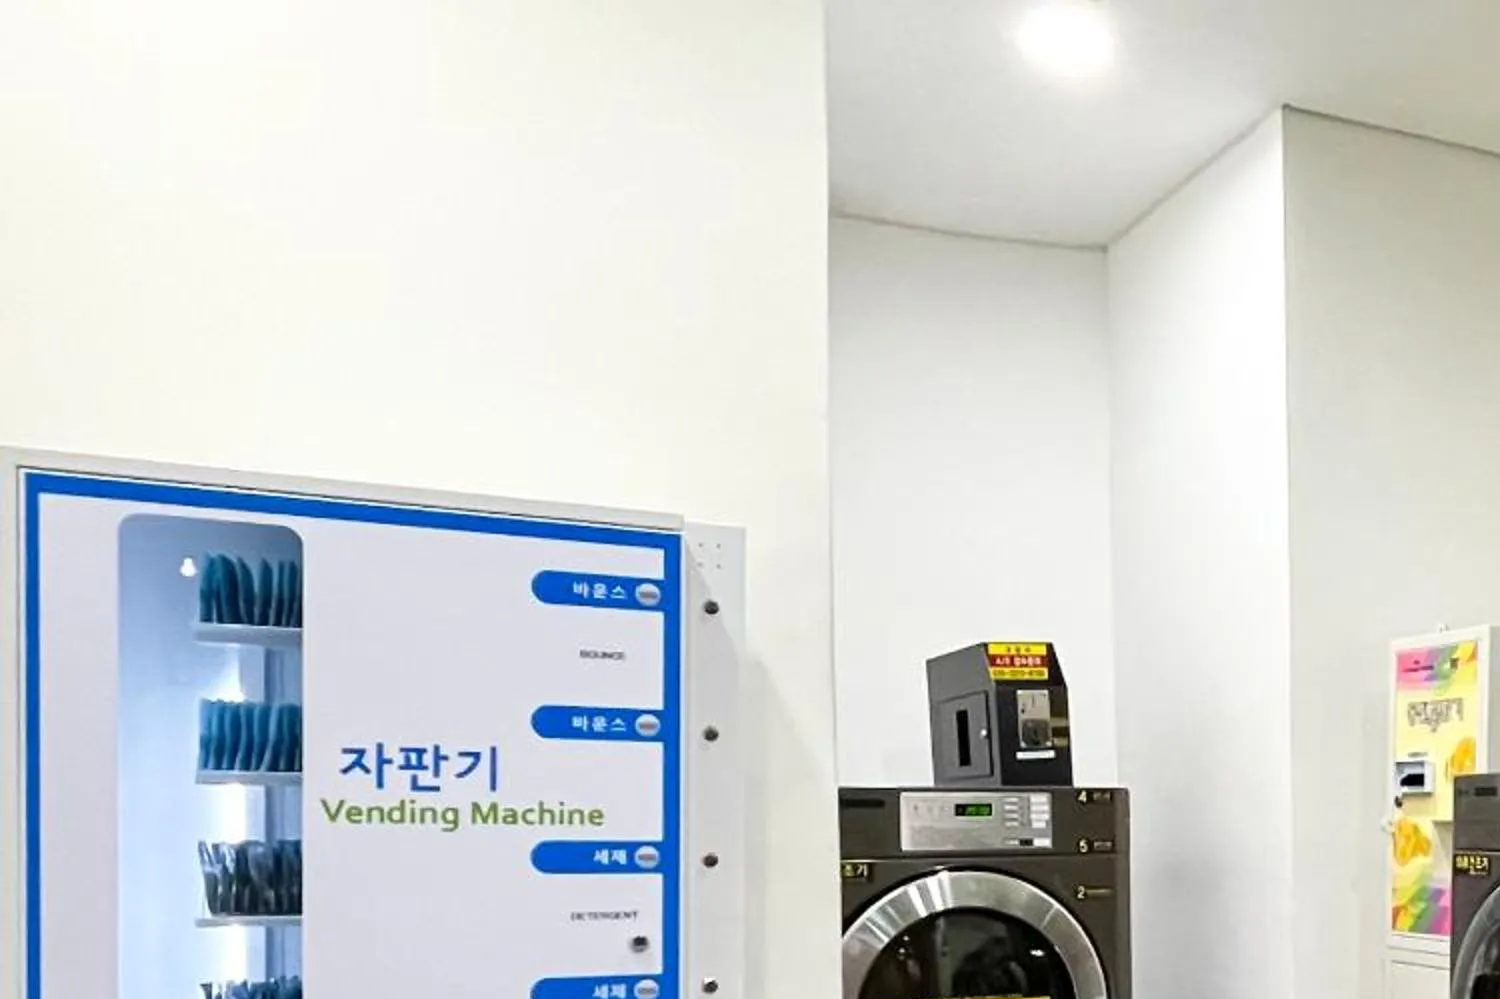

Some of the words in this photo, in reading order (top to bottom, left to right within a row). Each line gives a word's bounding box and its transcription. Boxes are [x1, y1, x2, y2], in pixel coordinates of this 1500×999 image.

[572, 581, 628, 600] 바운스
[571, 714, 628, 733] 바운스
[338, 742, 499, 793] 자판기
[1077, 789, 1087, 803] 4
[320, 797, 461, 833] Vending
[470, 801, 605, 827] Machine
